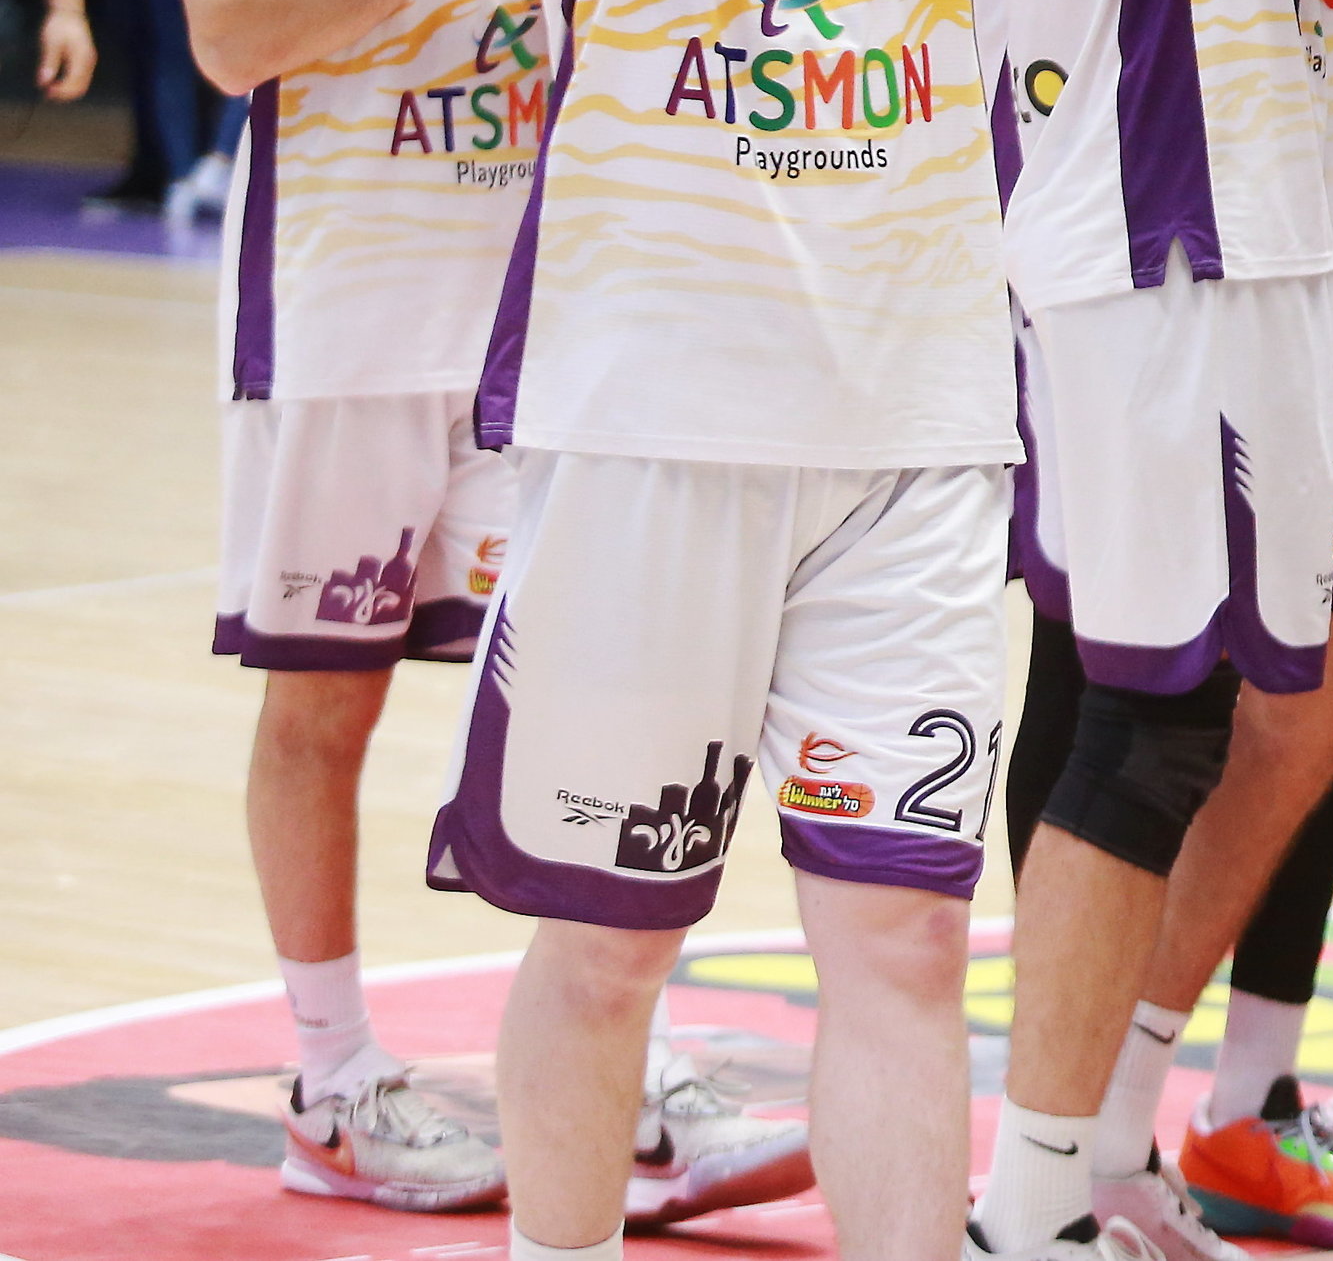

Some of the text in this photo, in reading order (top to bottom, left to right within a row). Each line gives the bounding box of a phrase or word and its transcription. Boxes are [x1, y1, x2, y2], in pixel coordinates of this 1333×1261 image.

[665, 37, 932, 131] ATSMON
[390, 78, 556, 156] ATSM
[736, 136, 888, 179] Paygrounds
[556, 789, 624, 813] Reebok
